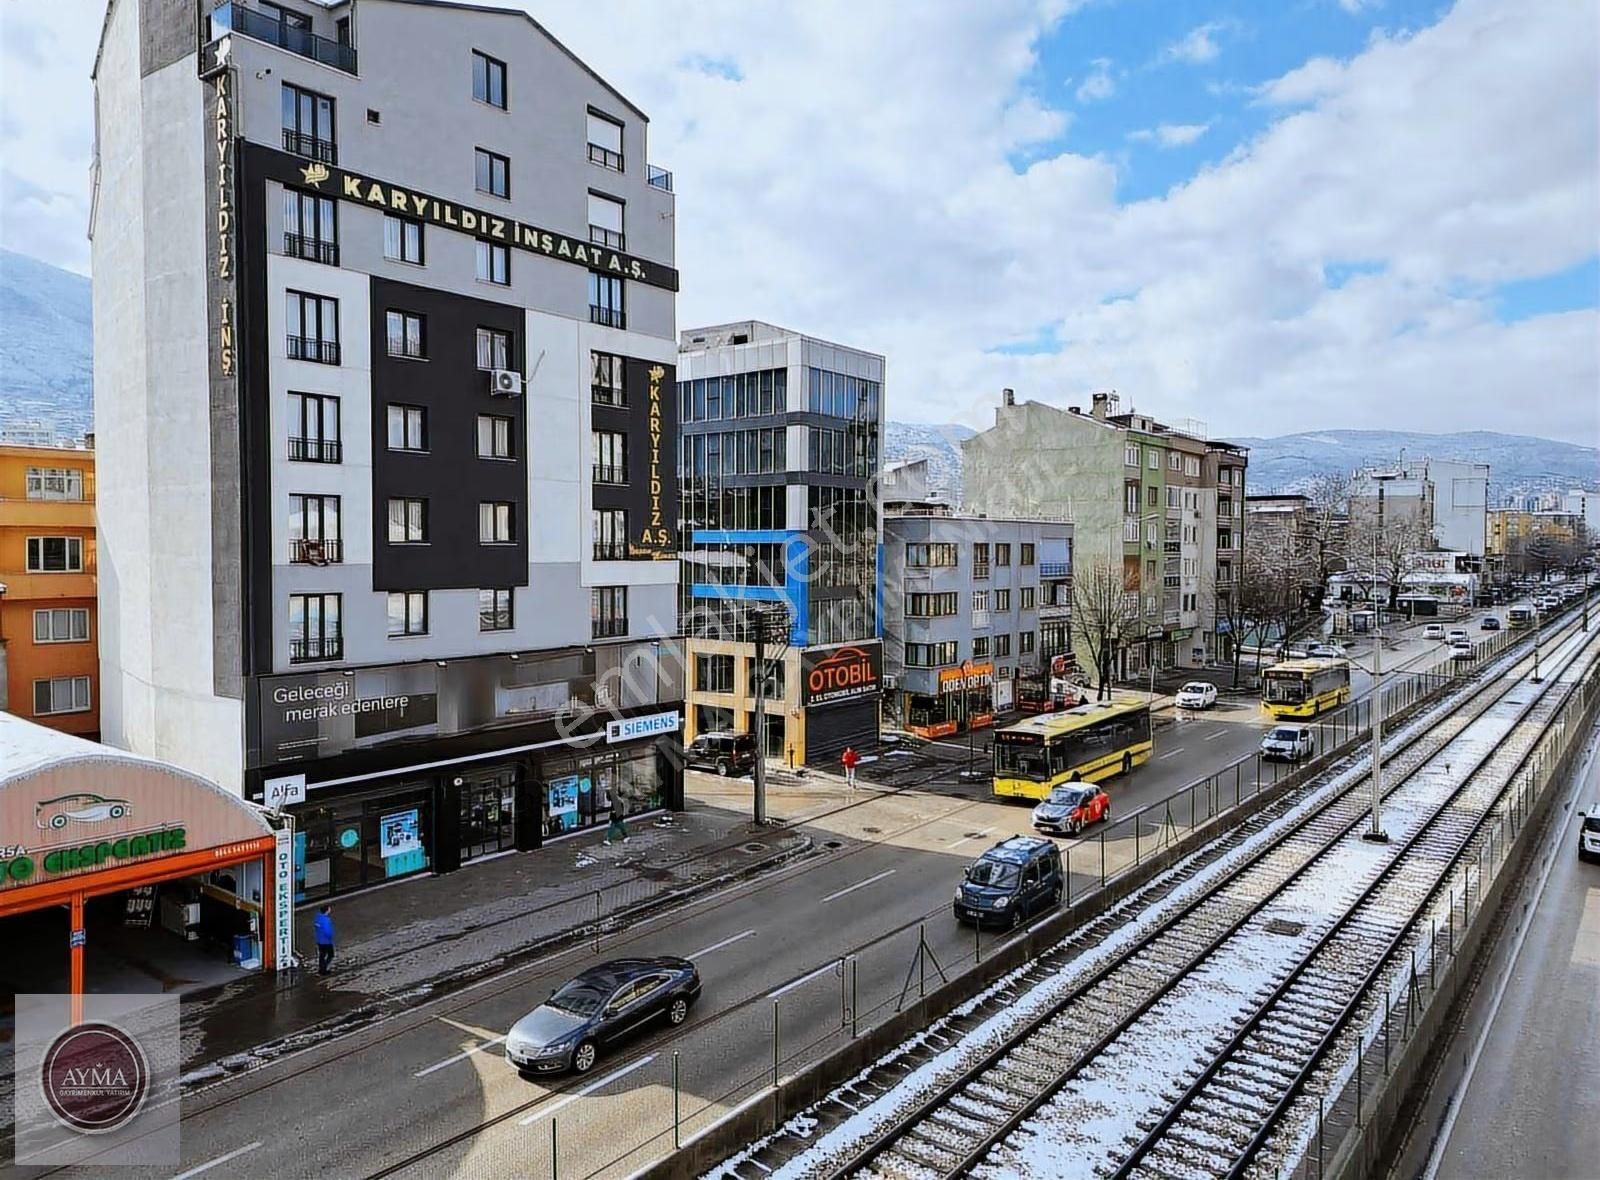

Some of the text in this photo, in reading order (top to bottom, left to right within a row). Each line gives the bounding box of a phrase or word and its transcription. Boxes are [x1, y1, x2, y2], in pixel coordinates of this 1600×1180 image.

[216, 74, 229, 277] KARYILDIZ
[343, 175, 647, 279] KARYILDIZ İNŞAAT A.Ş.
[650, 386, 661, 526] KARYILDIZ
[642, 528, 671, 547] A.Ş.
[809, 658, 877, 692] OTOBİL
[273, 681, 349, 703] Geleceği
[286, 695, 409, 722] merak edenlere
[624, 715, 675, 736] SIEMENS
